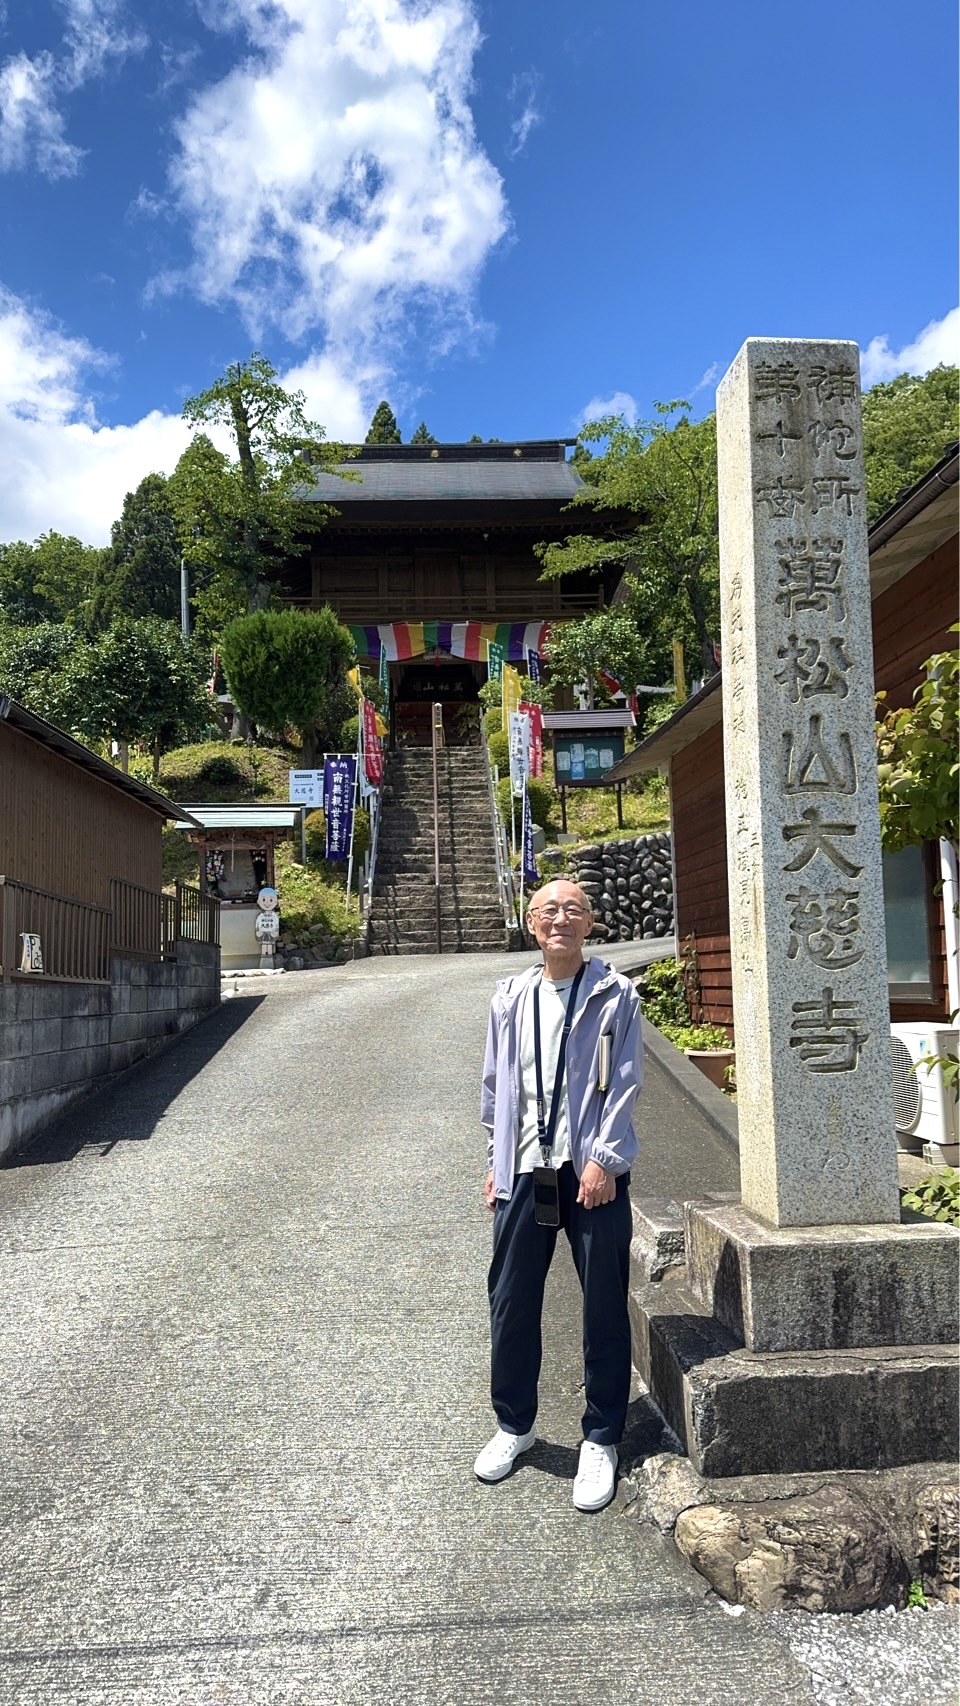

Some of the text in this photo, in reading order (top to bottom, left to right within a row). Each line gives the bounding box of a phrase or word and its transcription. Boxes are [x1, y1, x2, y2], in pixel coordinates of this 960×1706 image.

[774, 536, 870, 1075] 萬松山大慈寺
